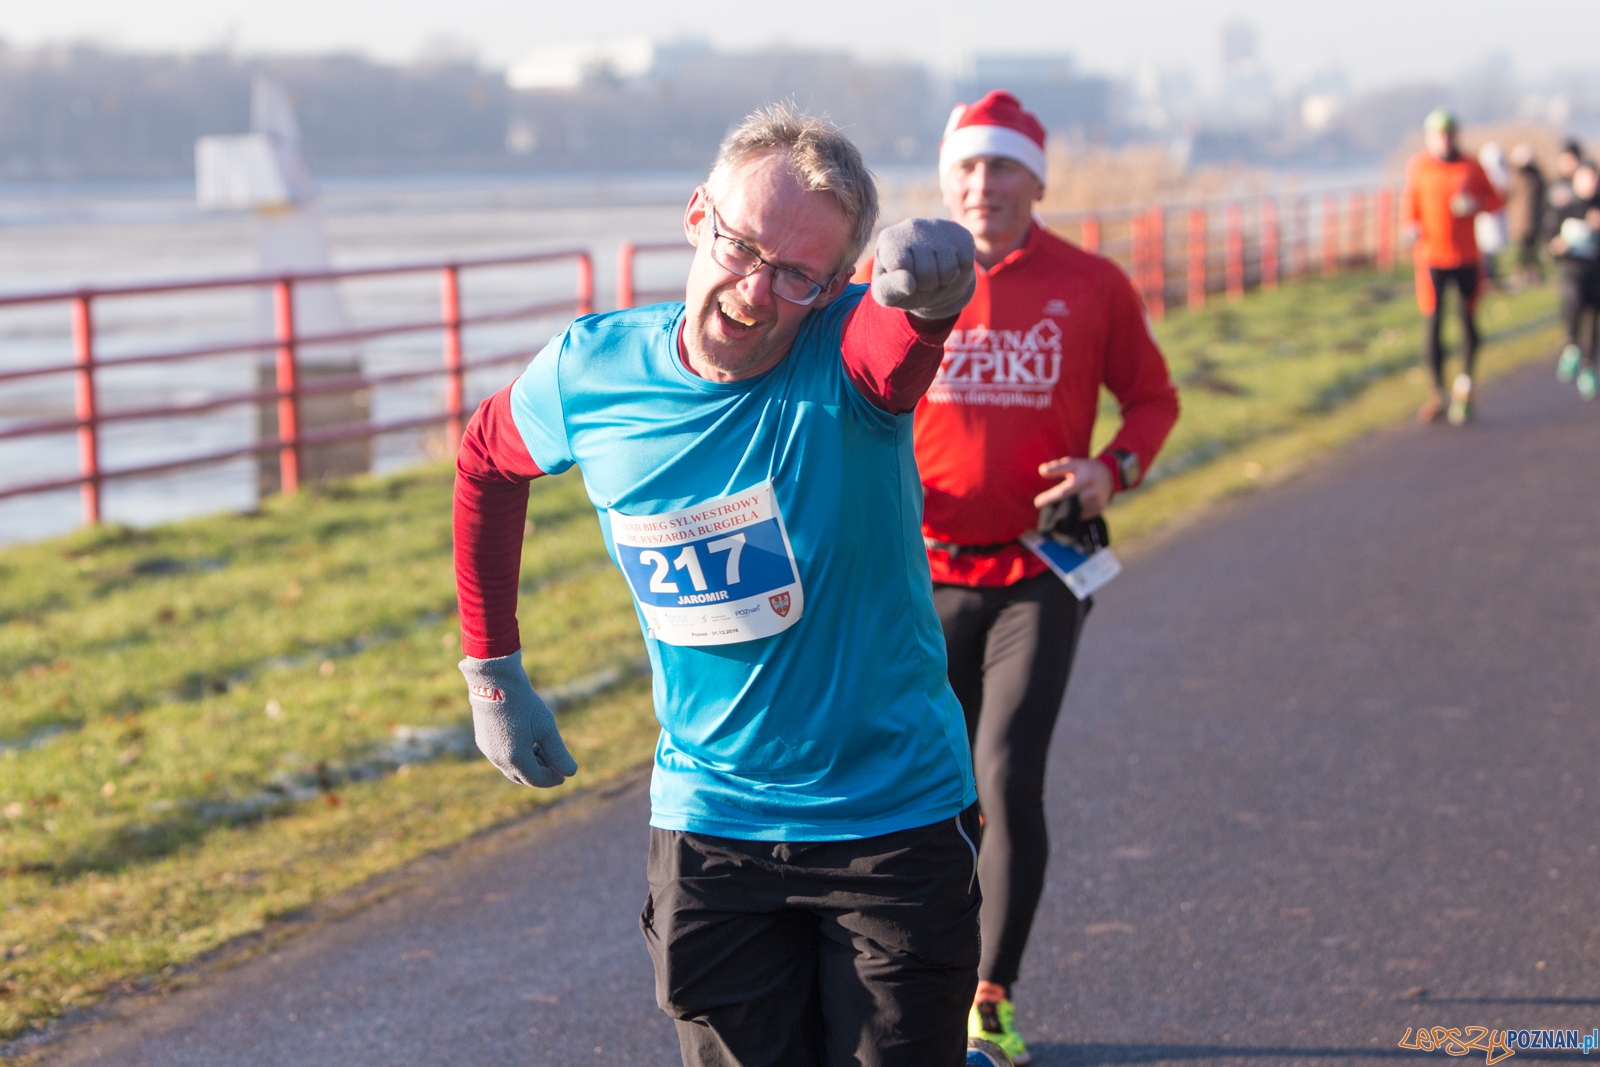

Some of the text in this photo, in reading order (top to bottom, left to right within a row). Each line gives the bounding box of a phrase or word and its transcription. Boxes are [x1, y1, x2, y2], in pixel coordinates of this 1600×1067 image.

[642, 521, 668, 532] BIEG
[670, 494, 760, 529] SYLWESTROWY
[642, 526, 696, 543] RYSZARDA
[697, 510, 759, 535] BURGIELA
[639, 532, 747, 594] 217
[677, 590, 729, 605] JAROMIR
